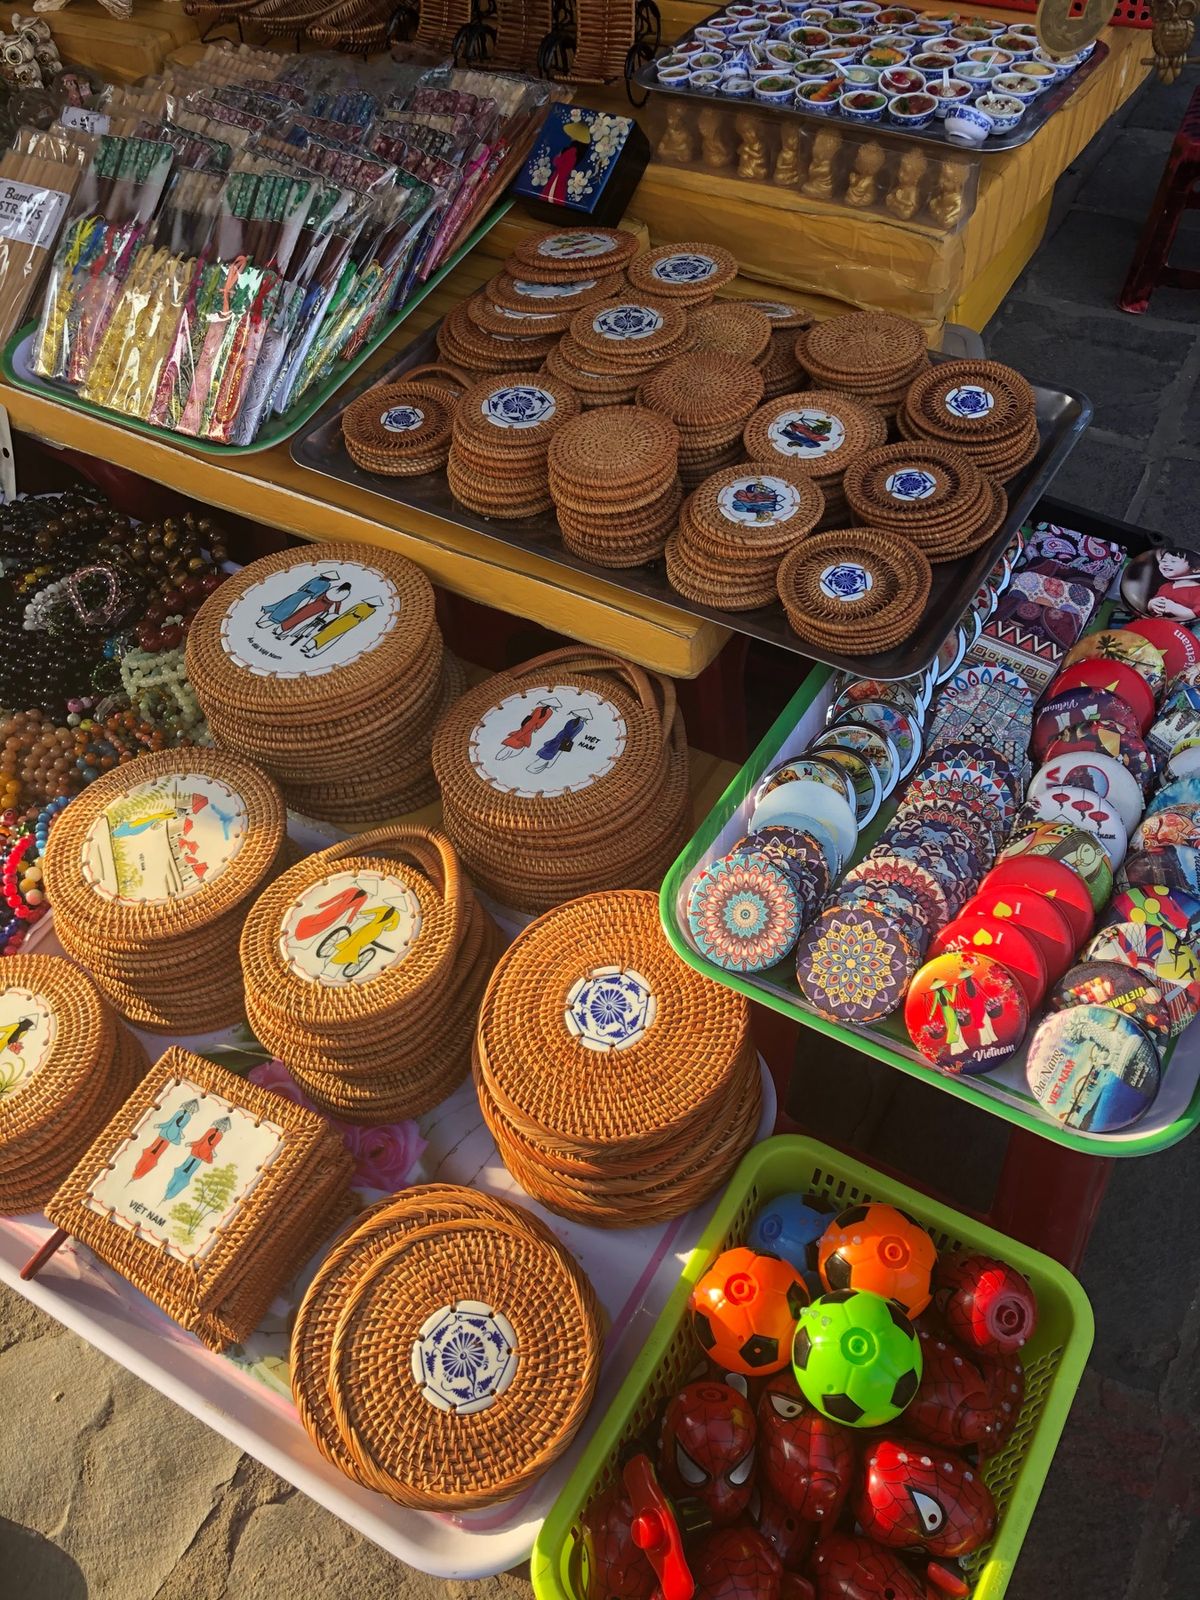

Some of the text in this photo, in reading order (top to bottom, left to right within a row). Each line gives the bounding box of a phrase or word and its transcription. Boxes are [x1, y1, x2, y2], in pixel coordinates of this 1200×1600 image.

[972, 1043, 1016, 1062] Vietnam
[1059, 1059, 1075, 1083] NAM
[145, 1211, 166, 1227] NAM
